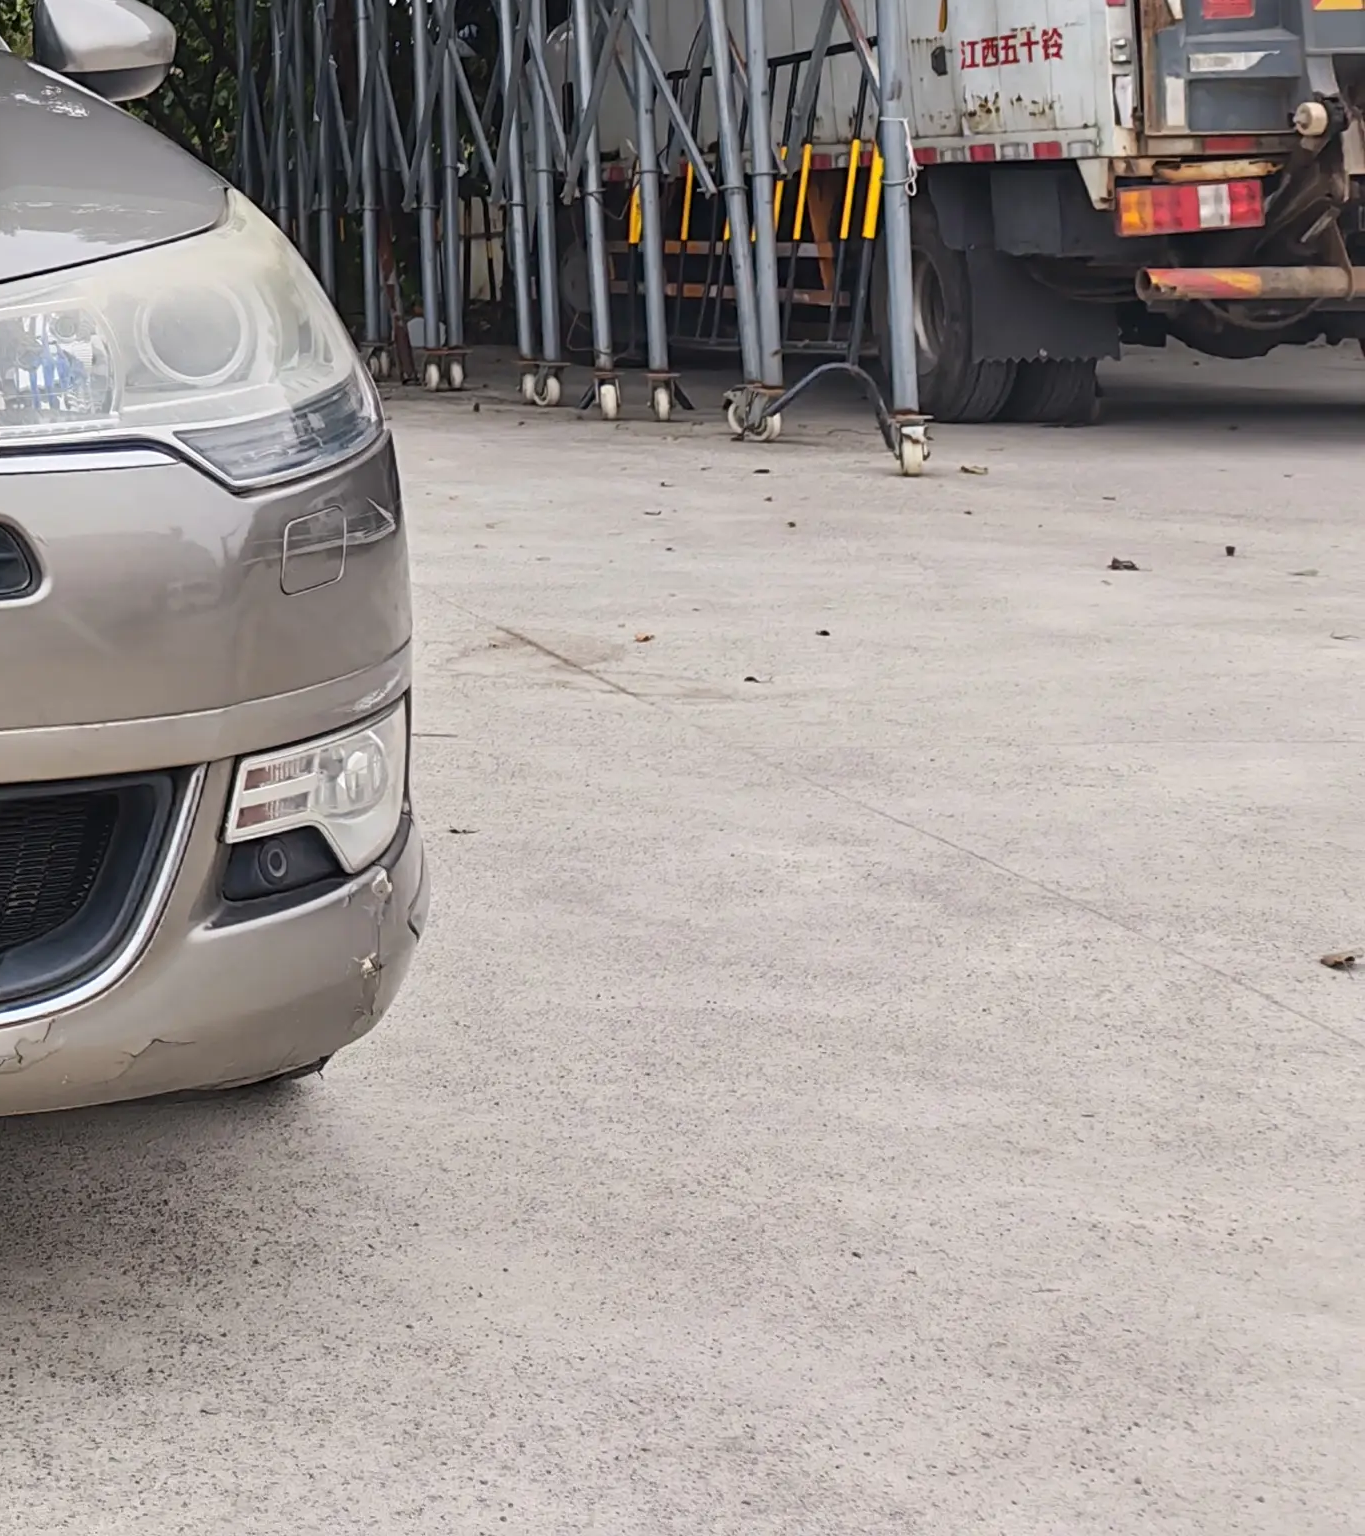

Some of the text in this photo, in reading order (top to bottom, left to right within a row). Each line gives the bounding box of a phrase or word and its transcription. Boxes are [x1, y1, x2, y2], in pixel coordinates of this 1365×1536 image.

[960, 27, 1063, 70] 江西五十铃
